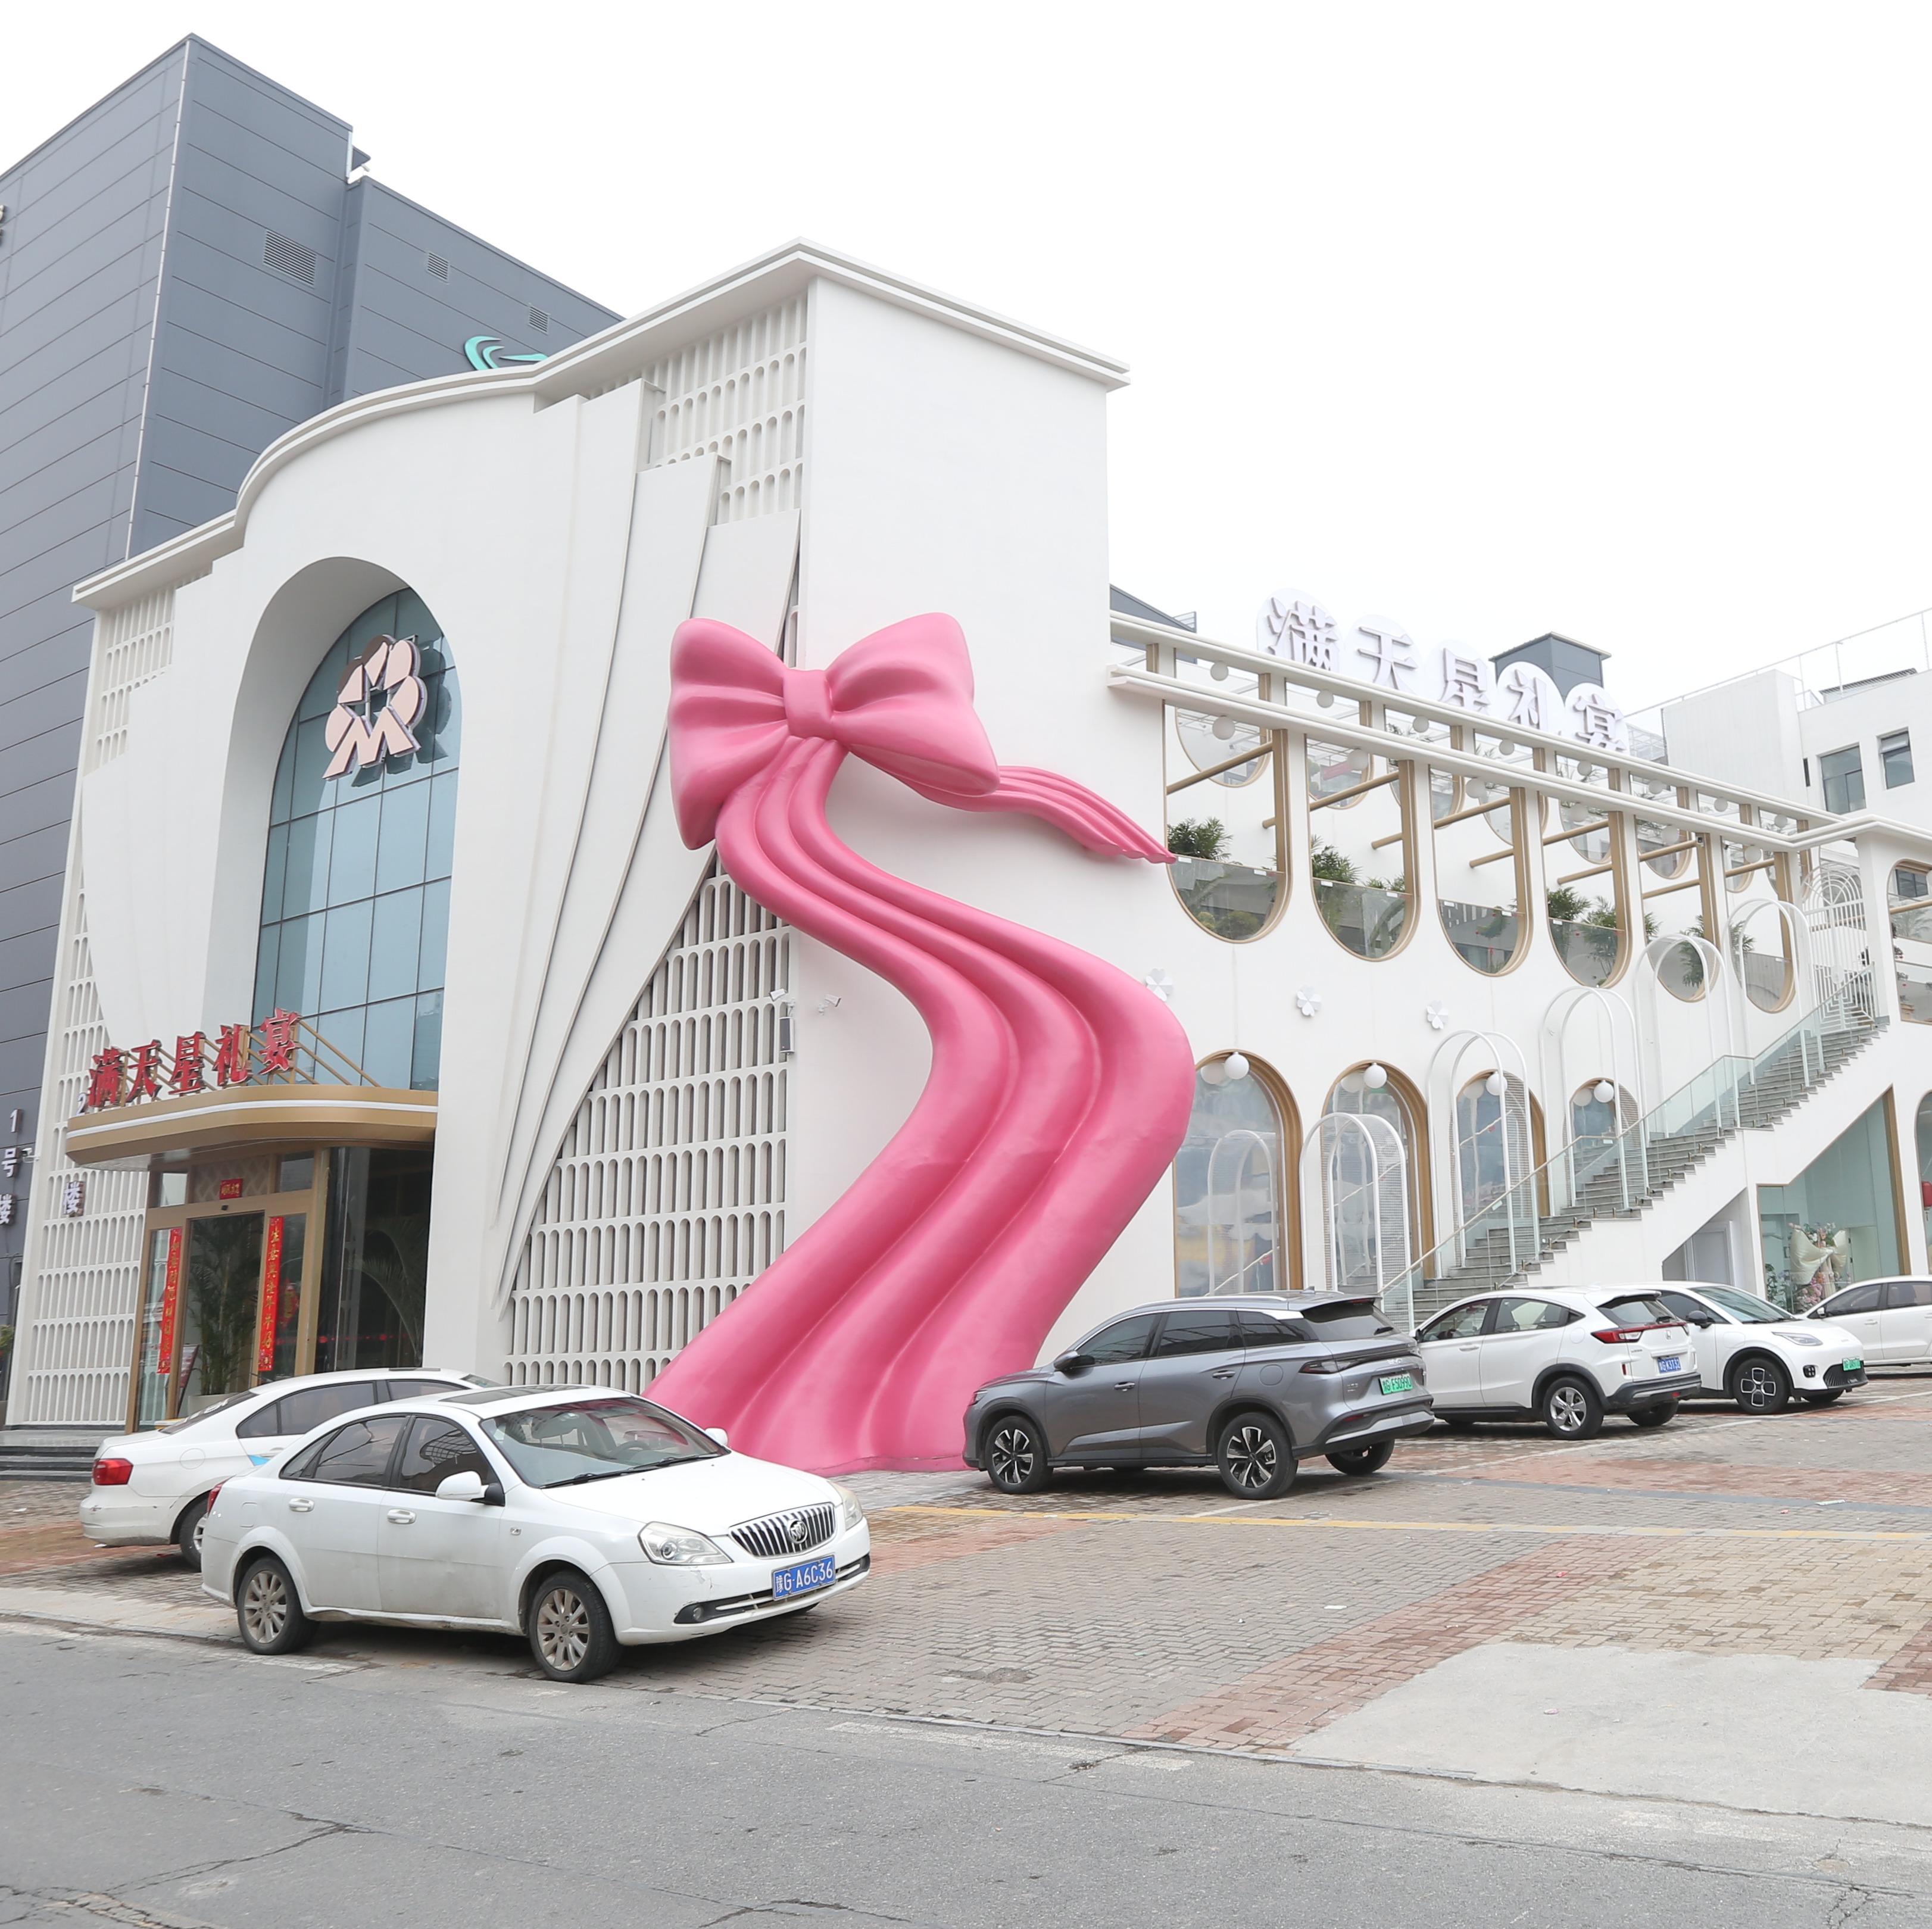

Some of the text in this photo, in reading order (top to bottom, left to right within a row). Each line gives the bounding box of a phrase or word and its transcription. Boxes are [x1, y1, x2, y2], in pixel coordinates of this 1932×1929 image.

[1266, 597, 1626, 751] 满天星礼宴
[88, 1007, 299, 1107] 满天星礼宴
